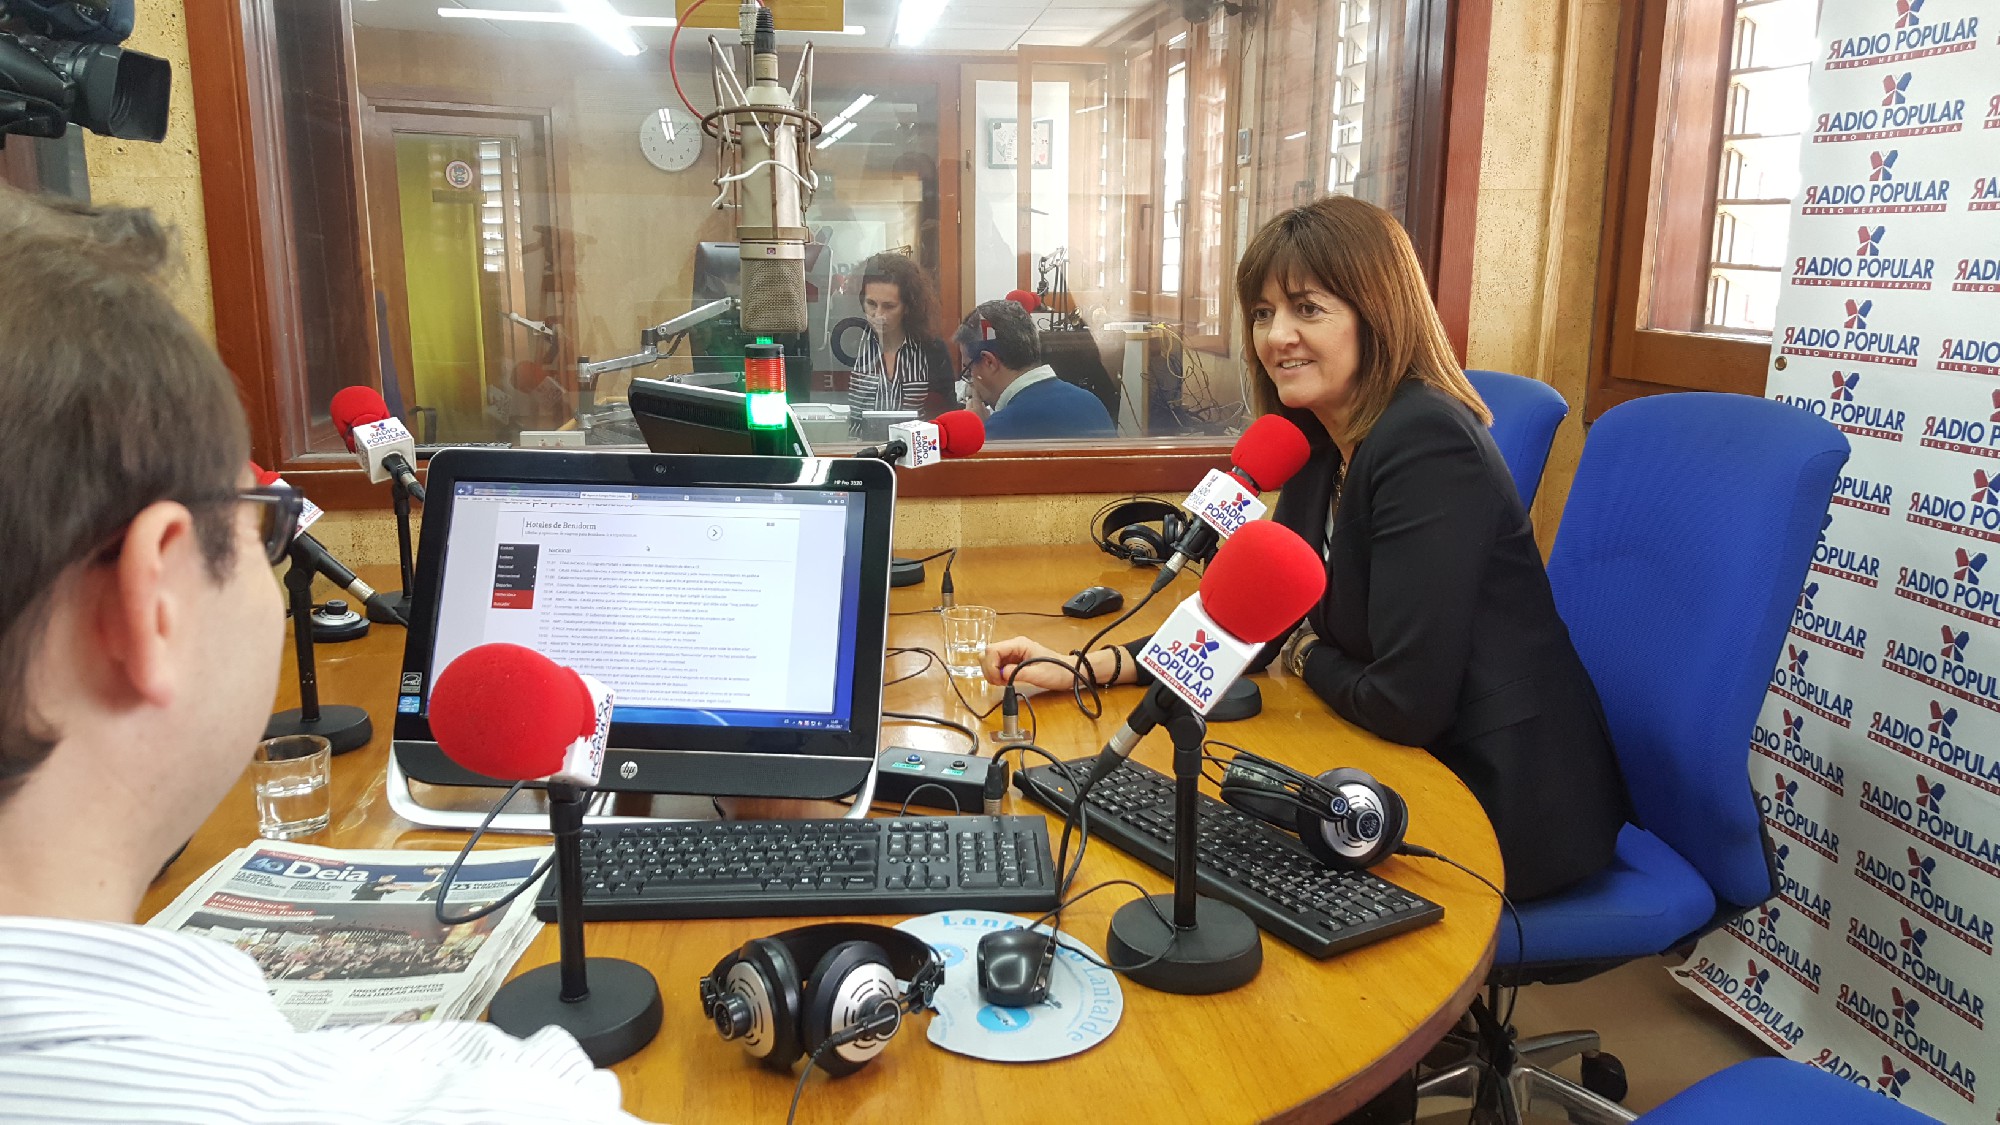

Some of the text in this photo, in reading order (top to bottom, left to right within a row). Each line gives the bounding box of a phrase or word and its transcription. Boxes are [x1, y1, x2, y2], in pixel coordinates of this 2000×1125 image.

[1896, 17, 1978, 48] POPULAR
[1882, 100, 1965, 128] POPULAR
[1870, 180, 1950, 203] POPULAR
[1805, 204, 1942, 214] BILBO HERRI IRRATIA
[1857, 258, 1934, 279] POPULAR
[1795, 278, 1928, 290] BILBO HERRI IRRATIA
[1956, 282, 1994, 292] BILBO
[1784, 347, 1914, 367] BILBO HERRI IRRATIA
[1844, 330, 1920, 356] POPULAR
[1940, 362, 1977, 372] BILBO
[1830, 402, 1906, 431] POPULAR
[366, 430, 408, 445] POPULAR
[1856, 428, 1900, 440] IRRATIA
[1924, 440, 1960, 450] BILBO
[1833, 476, 1892, 505] OPULAR
[1842, 496, 1888, 514] IRRATIA
[526, 521, 552, 529] Hoteles
[563, 522, 596, 530] Benidorm
[1204, 502, 1238, 532] POPULA
[1910, 514, 1990, 540] BILBO HERRI
[1813, 544, 1880, 578] OPULAR
[1828, 567, 1874, 586] IRRATIA
[1938, 602, 1971, 618] HERRI
[1953, 582, 2000, 616] POPU
[1794, 608, 1867, 649] POPULAR
[1816, 636, 1861, 658] IRRATIA
[1148, 643, 1213, 702] POPULAR
[1941, 659, 2000, 700] POPUL
[1790, 674, 1853, 718] POPULAR
[622, 762, 636, 778] hp
[1784, 738, 1844, 787] POPULAR
[1911, 750, 1946, 772] HERRI
[1954, 770, 2000, 795] IRRATI
[1928, 734, 2000, 784] POPULA
[1776, 802, 1839, 854] POPULAR
[282, 860, 369, 882] Deia
[1778, 872, 1832, 920] OPULAR
[1910, 880, 1994, 945] POPULAR
[1758, 927, 1822, 984] POPULAR
[1902, 952, 1985, 1020] POPULAR
[1066, 964, 1116, 1042] Lantalde
[1737, 987, 1804, 1046] POPULAR
[1894, 1020, 1976, 1093] POPULAR
